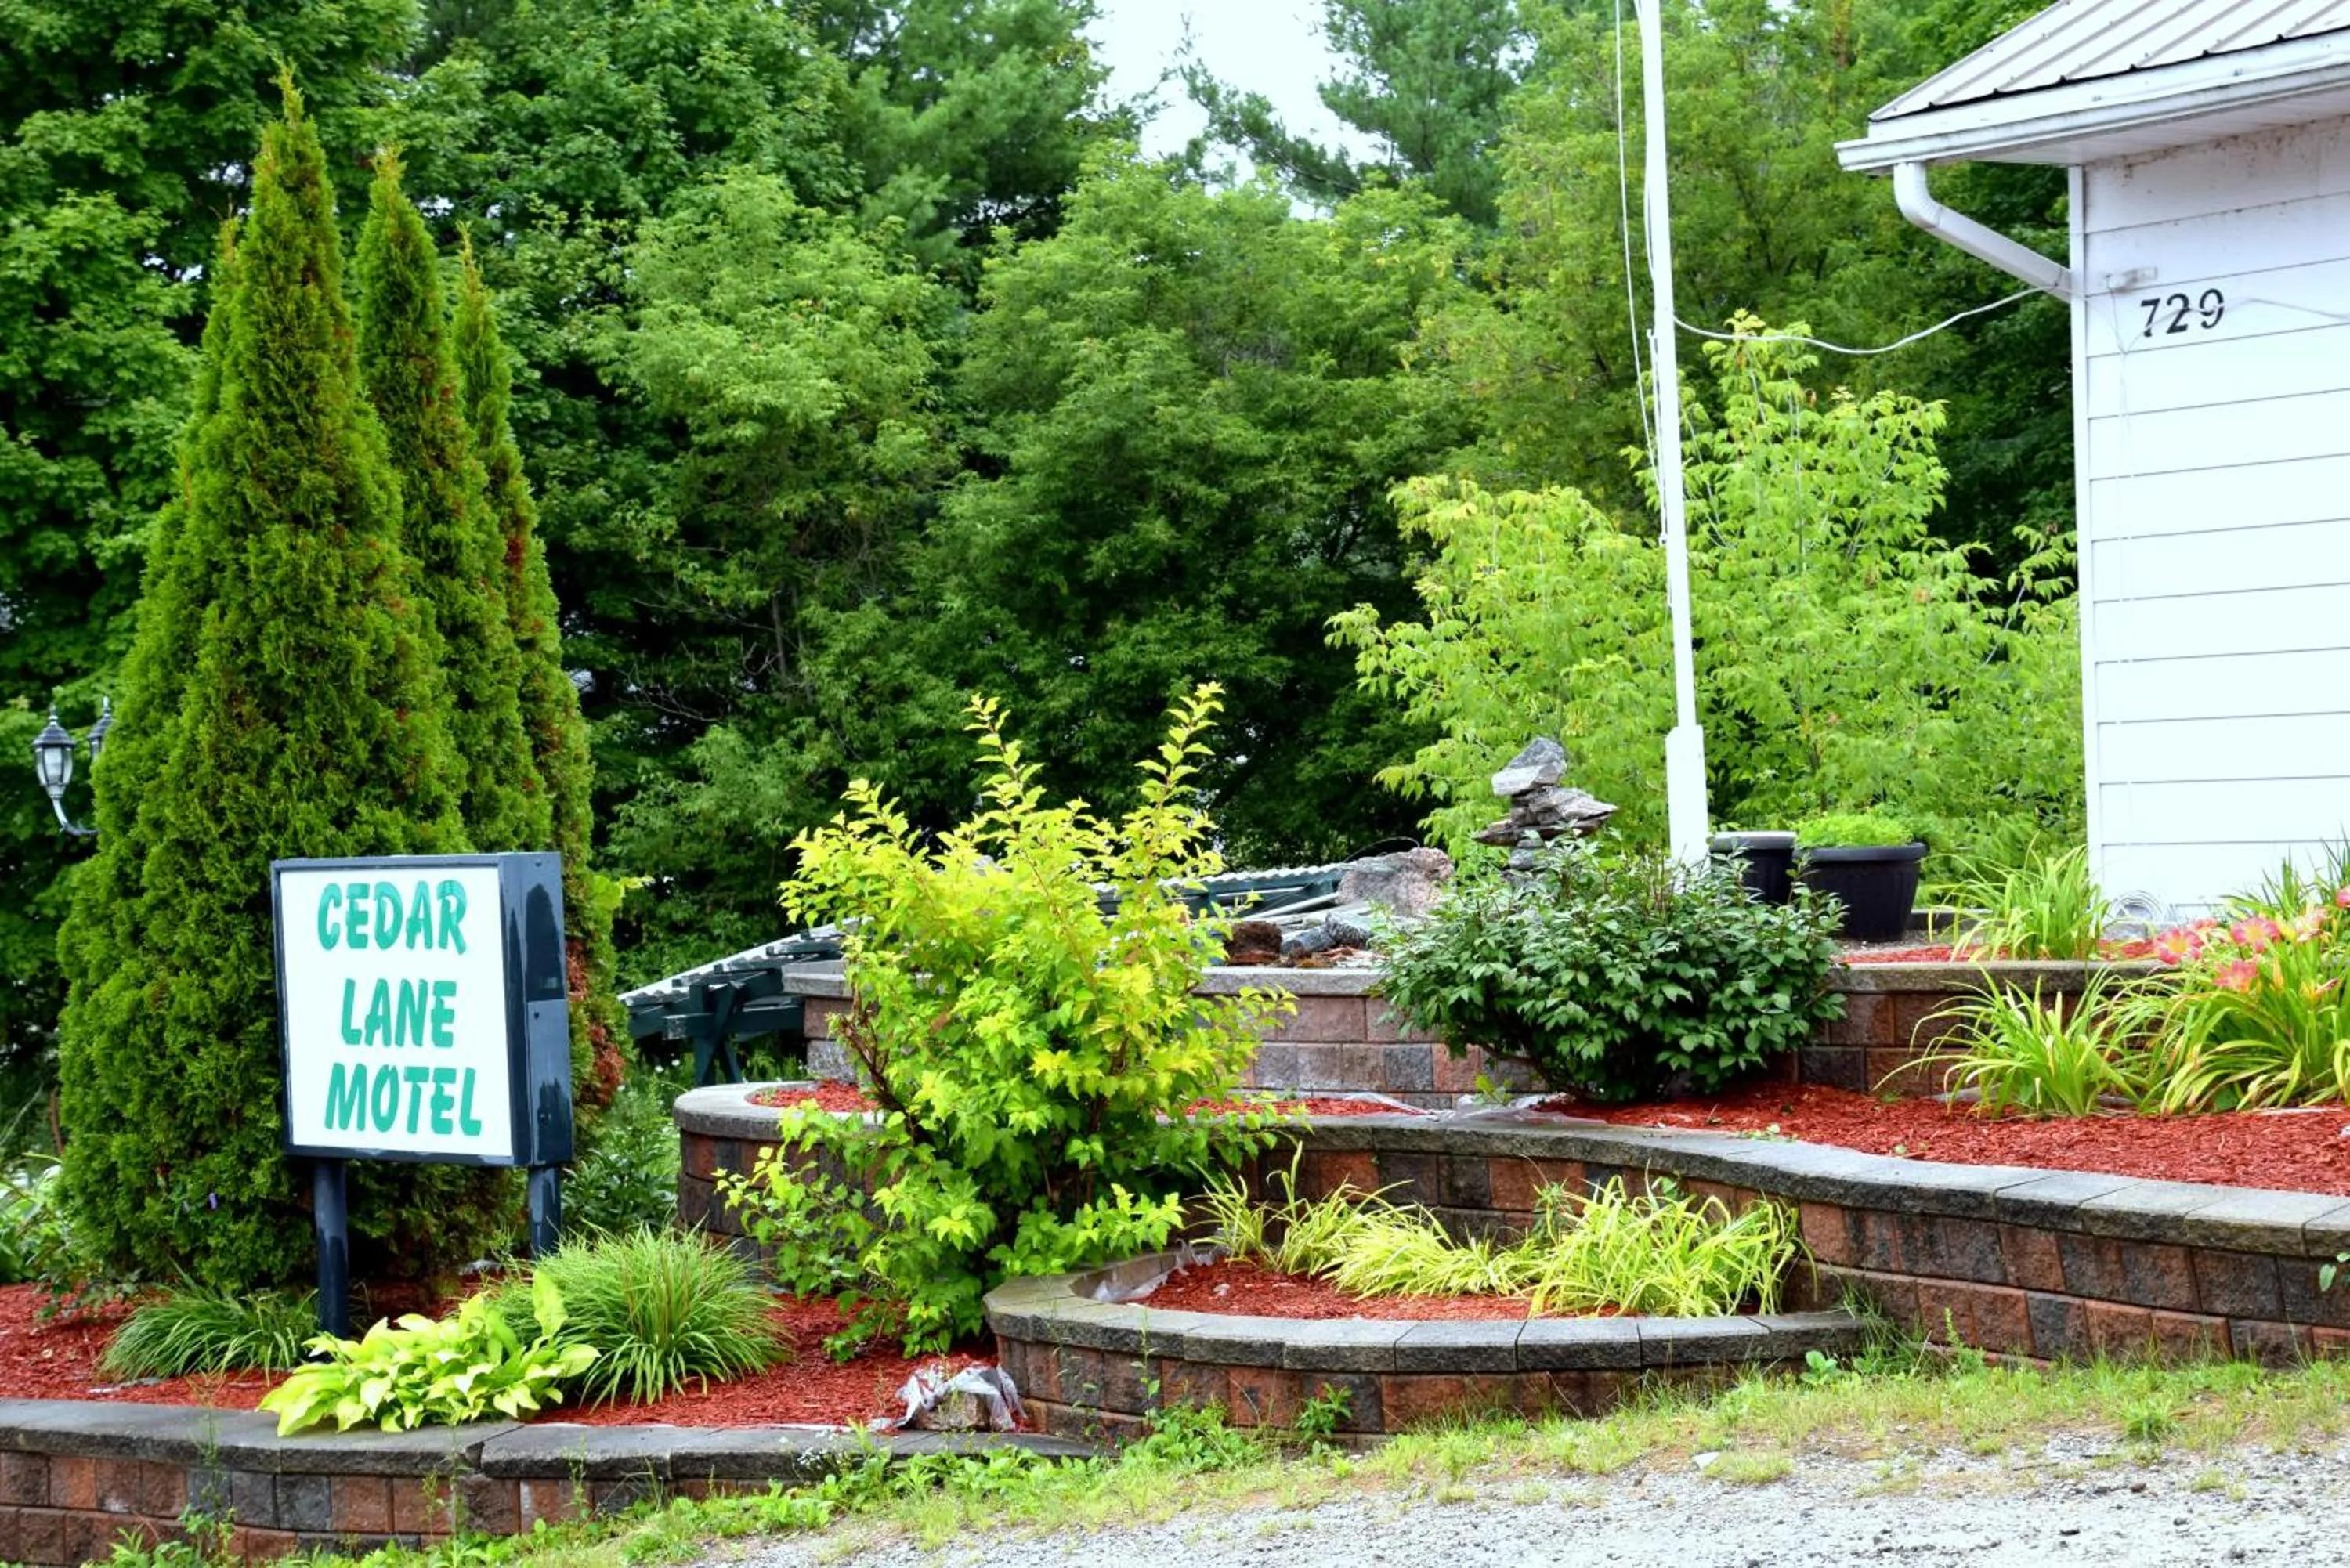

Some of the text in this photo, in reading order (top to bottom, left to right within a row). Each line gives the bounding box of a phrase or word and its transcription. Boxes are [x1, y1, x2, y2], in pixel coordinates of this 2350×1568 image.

[2140, 288, 2225, 338] 729
[317, 879, 468, 955] CEDAR
[341, 977, 458, 1048] LANE
[324, 1062, 483, 1136] MOTEL
